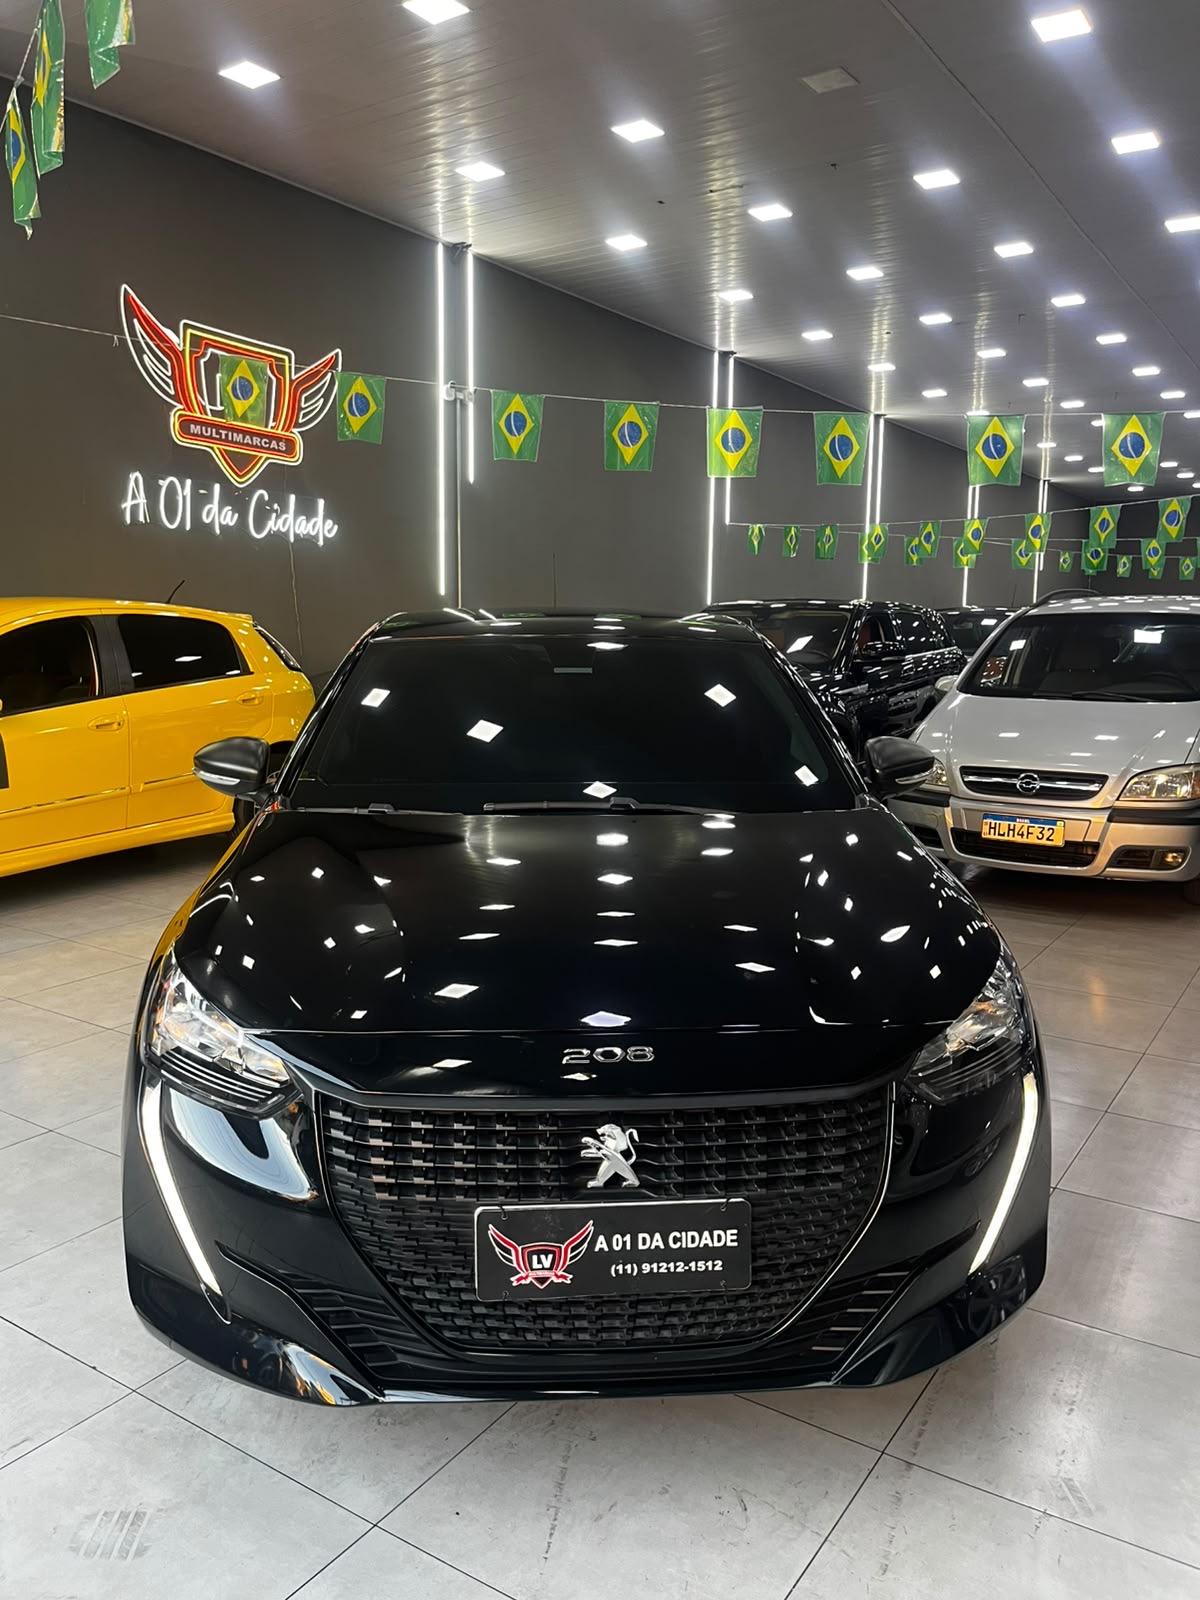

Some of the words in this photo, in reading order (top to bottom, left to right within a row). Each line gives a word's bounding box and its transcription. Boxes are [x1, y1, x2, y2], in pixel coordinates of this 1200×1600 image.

[189, 423, 287, 452] MULTIMARCAS
[121, 471, 149, 524] A
[201, 483, 239, 535] da
[249, 489, 339, 547] Cidade
[988, 821, 1055, 842] HLH4F32
[561, 1046, 655, 1064] 208
[594, 1235, 609, 1252] A
[612, 1233, 633, 1251] 01
[638, 1232, 665, 1250] DA
[668, 1229, 739, 1249] CIDADE
[532, 1253, 554, 1269] LV
[610, 1262, 639, 1277] (11)
[641, 1260, 724, 1275] 91212-1512
